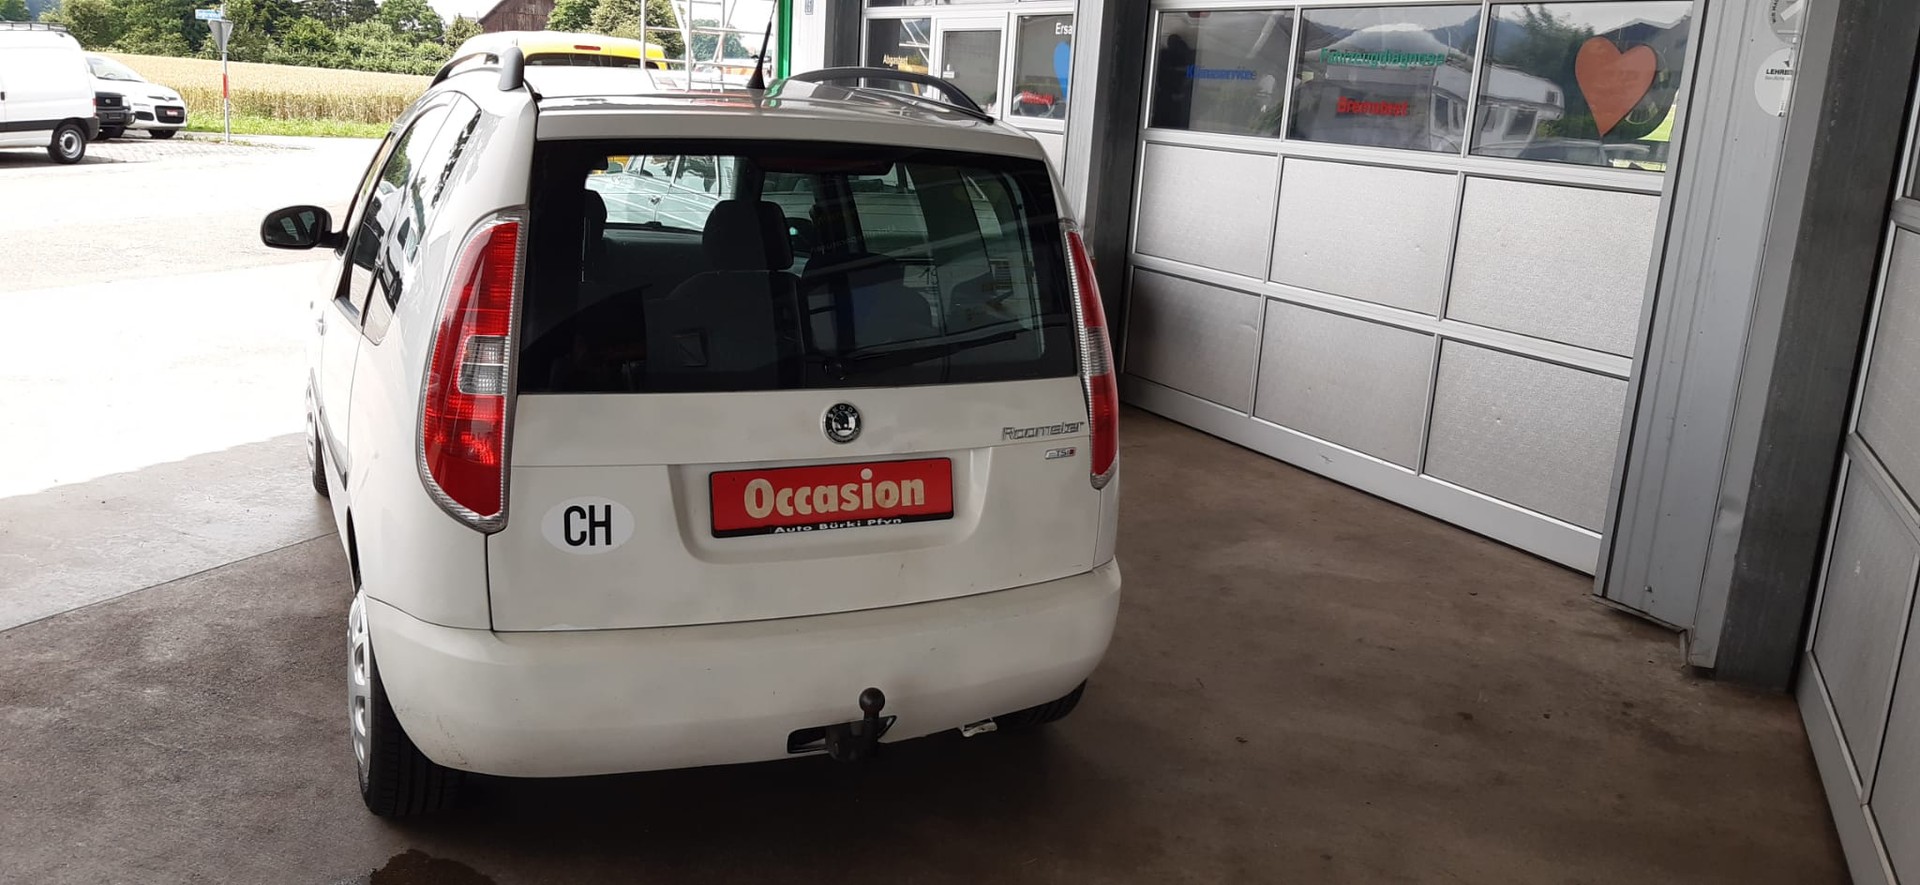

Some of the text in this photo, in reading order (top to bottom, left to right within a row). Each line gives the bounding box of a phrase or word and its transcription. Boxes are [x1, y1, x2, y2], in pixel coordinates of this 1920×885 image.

[1002, 421, 1085, 441] Roomster
[743, 468, 925, 519] Occasion
[563, 504, 612, 546] CH
[774, 525, 813, 534] Auto
[819, 520, 861, 530] Bürki
